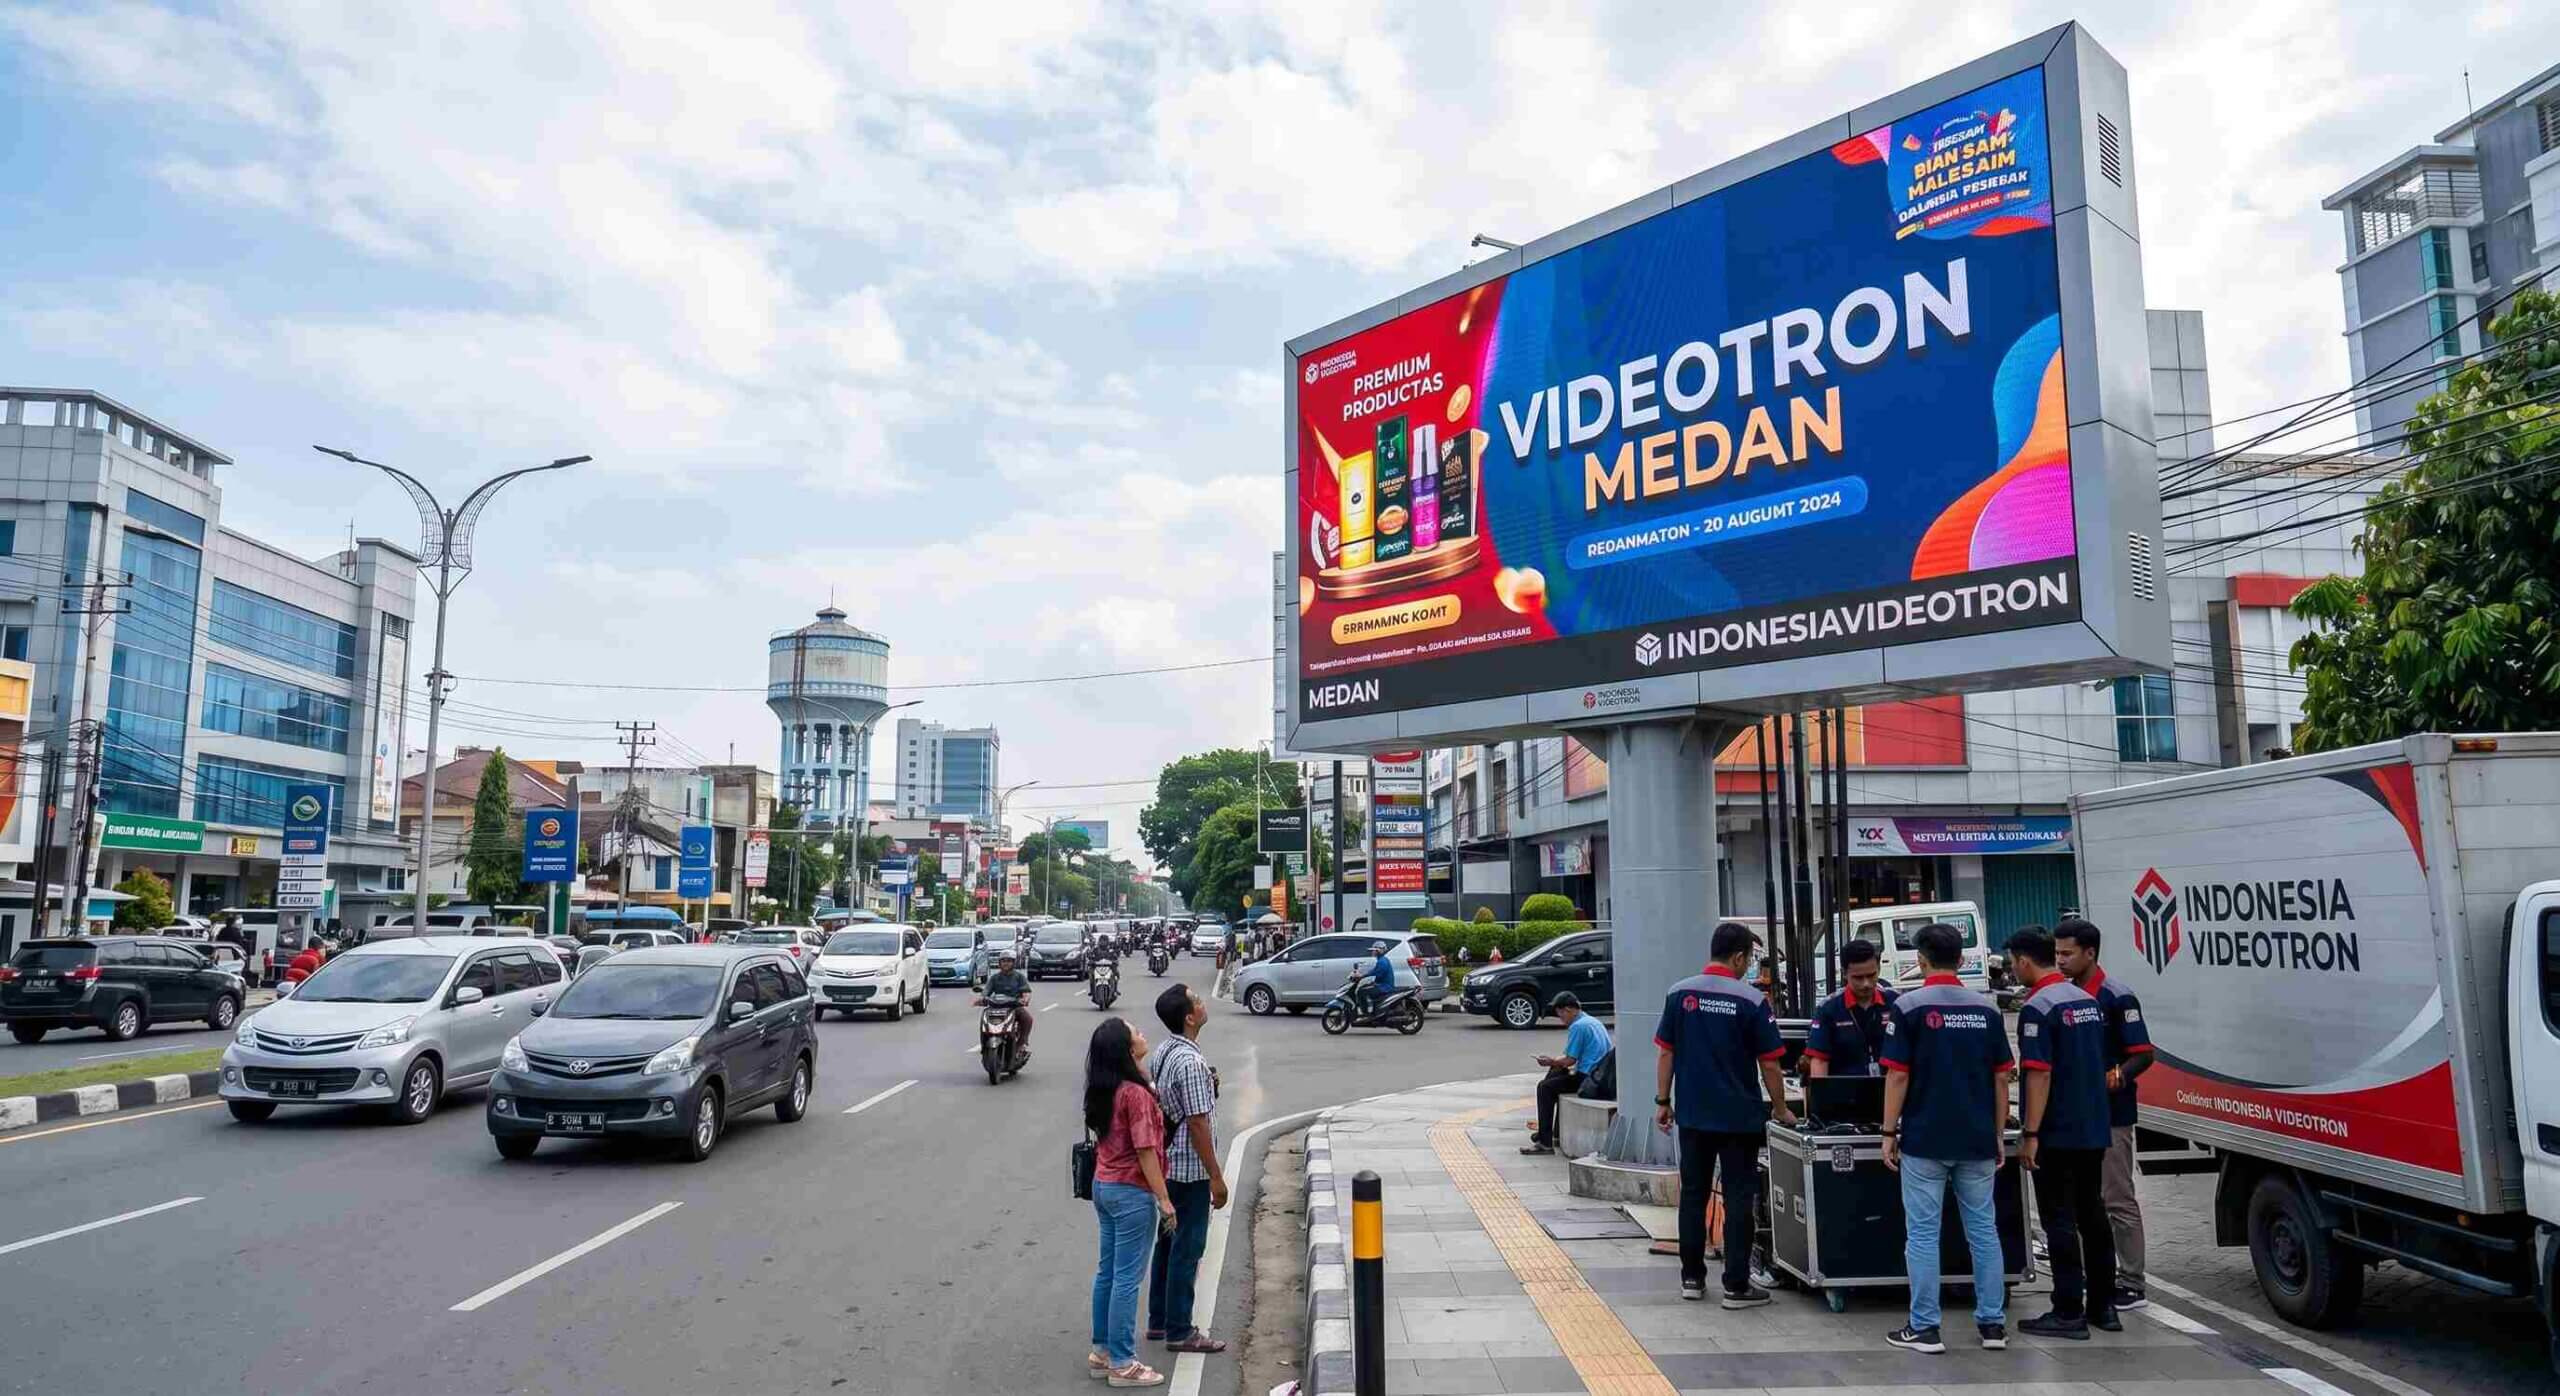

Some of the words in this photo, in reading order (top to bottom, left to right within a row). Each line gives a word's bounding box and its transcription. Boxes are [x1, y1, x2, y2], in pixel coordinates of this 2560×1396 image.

[1354, 352, 1431, 395] PREMIUM
[1499, 257, 1971, 459] VIDEOTRON
[1343, 372, 1444, 422] PRODUCTAS
[1584, 386, 1843, 511] MEDAN
[1704, 517, 1723, 533] 20
[1800, 490, 1842, 514] 2024
[1309, 679, 1380, 710] MEDAN
[1598, 687, 1640, 698] INDONESIA
[1598, 696, 1640, 707] VIDEOTRON
[2186, 877, 2355, 921] INDONESIA
[2188, 931, 2360, 972] VIDEOTRON
[2213, 1098, 2274, 1121] INDONESIA
[2274, 1108, 2349, 1138] VIDEOTRON
